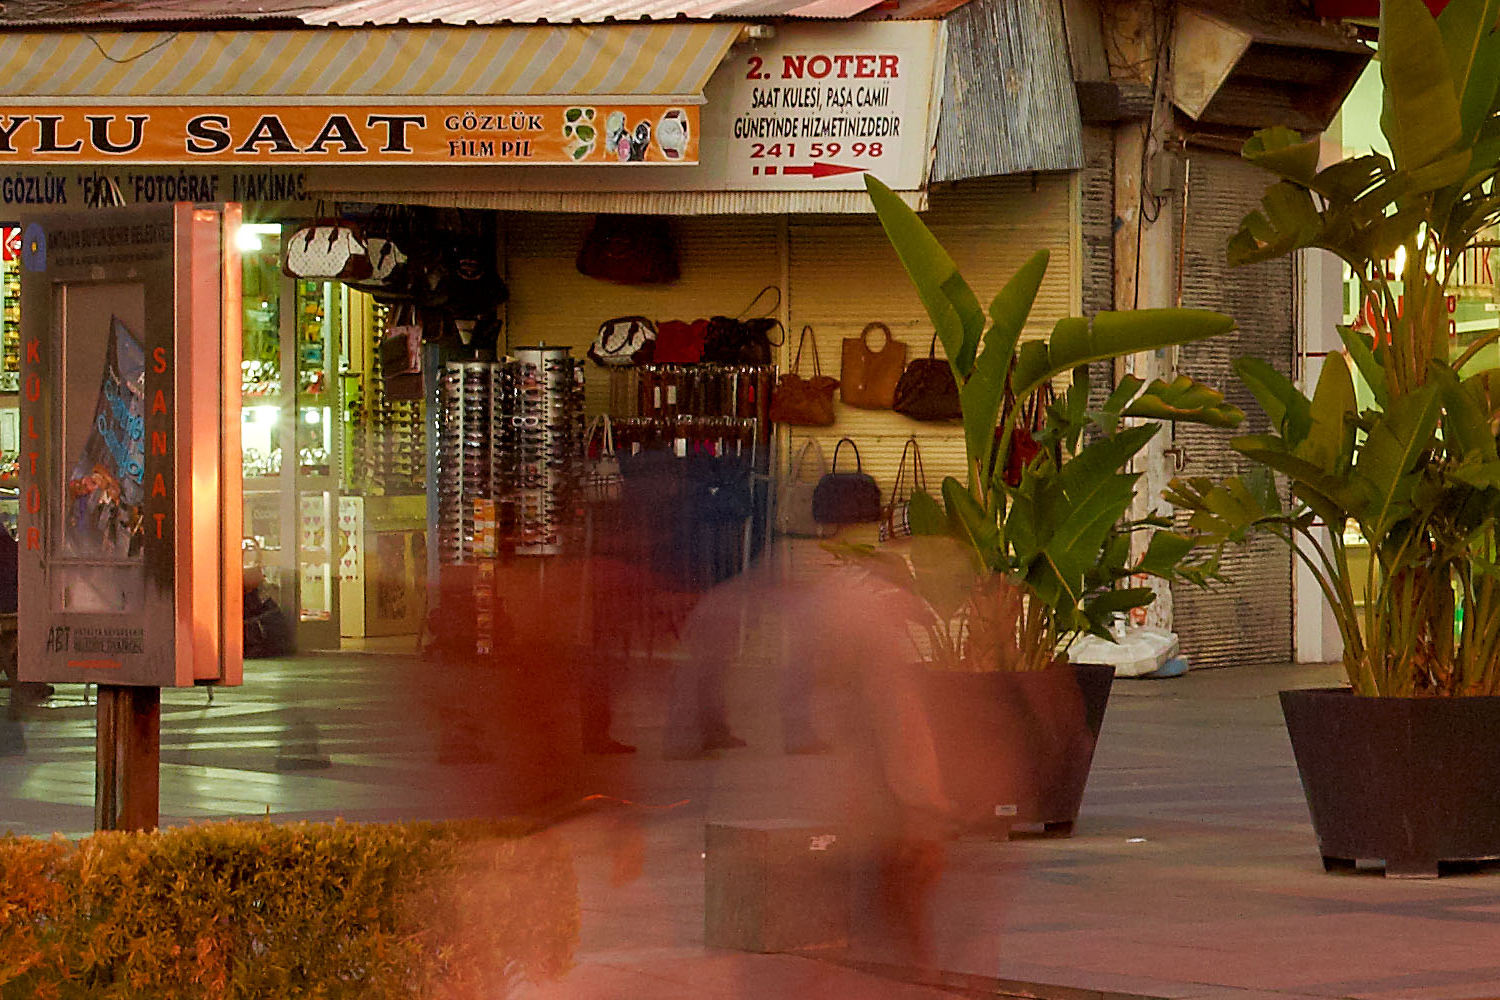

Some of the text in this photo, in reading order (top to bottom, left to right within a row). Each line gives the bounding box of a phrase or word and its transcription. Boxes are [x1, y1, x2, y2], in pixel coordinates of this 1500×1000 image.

[746, 54, 900, 80] 2. NOTER
[752, 80, 890, 112] SAAT KULESİ, PAŞA CAMİİ
[185, 112, 428, 155] SAAT
[444, 110, 543, 132] GÖZLÜK
[734, 110, 901, 139] GÜNEYİNDE HİZMETİNİZDEDİR
[447, 136, 533, 158] FİLM PİL
[750, 142, 883, 158] 241 59 98
[152, 347, 167, 540] SANAT
